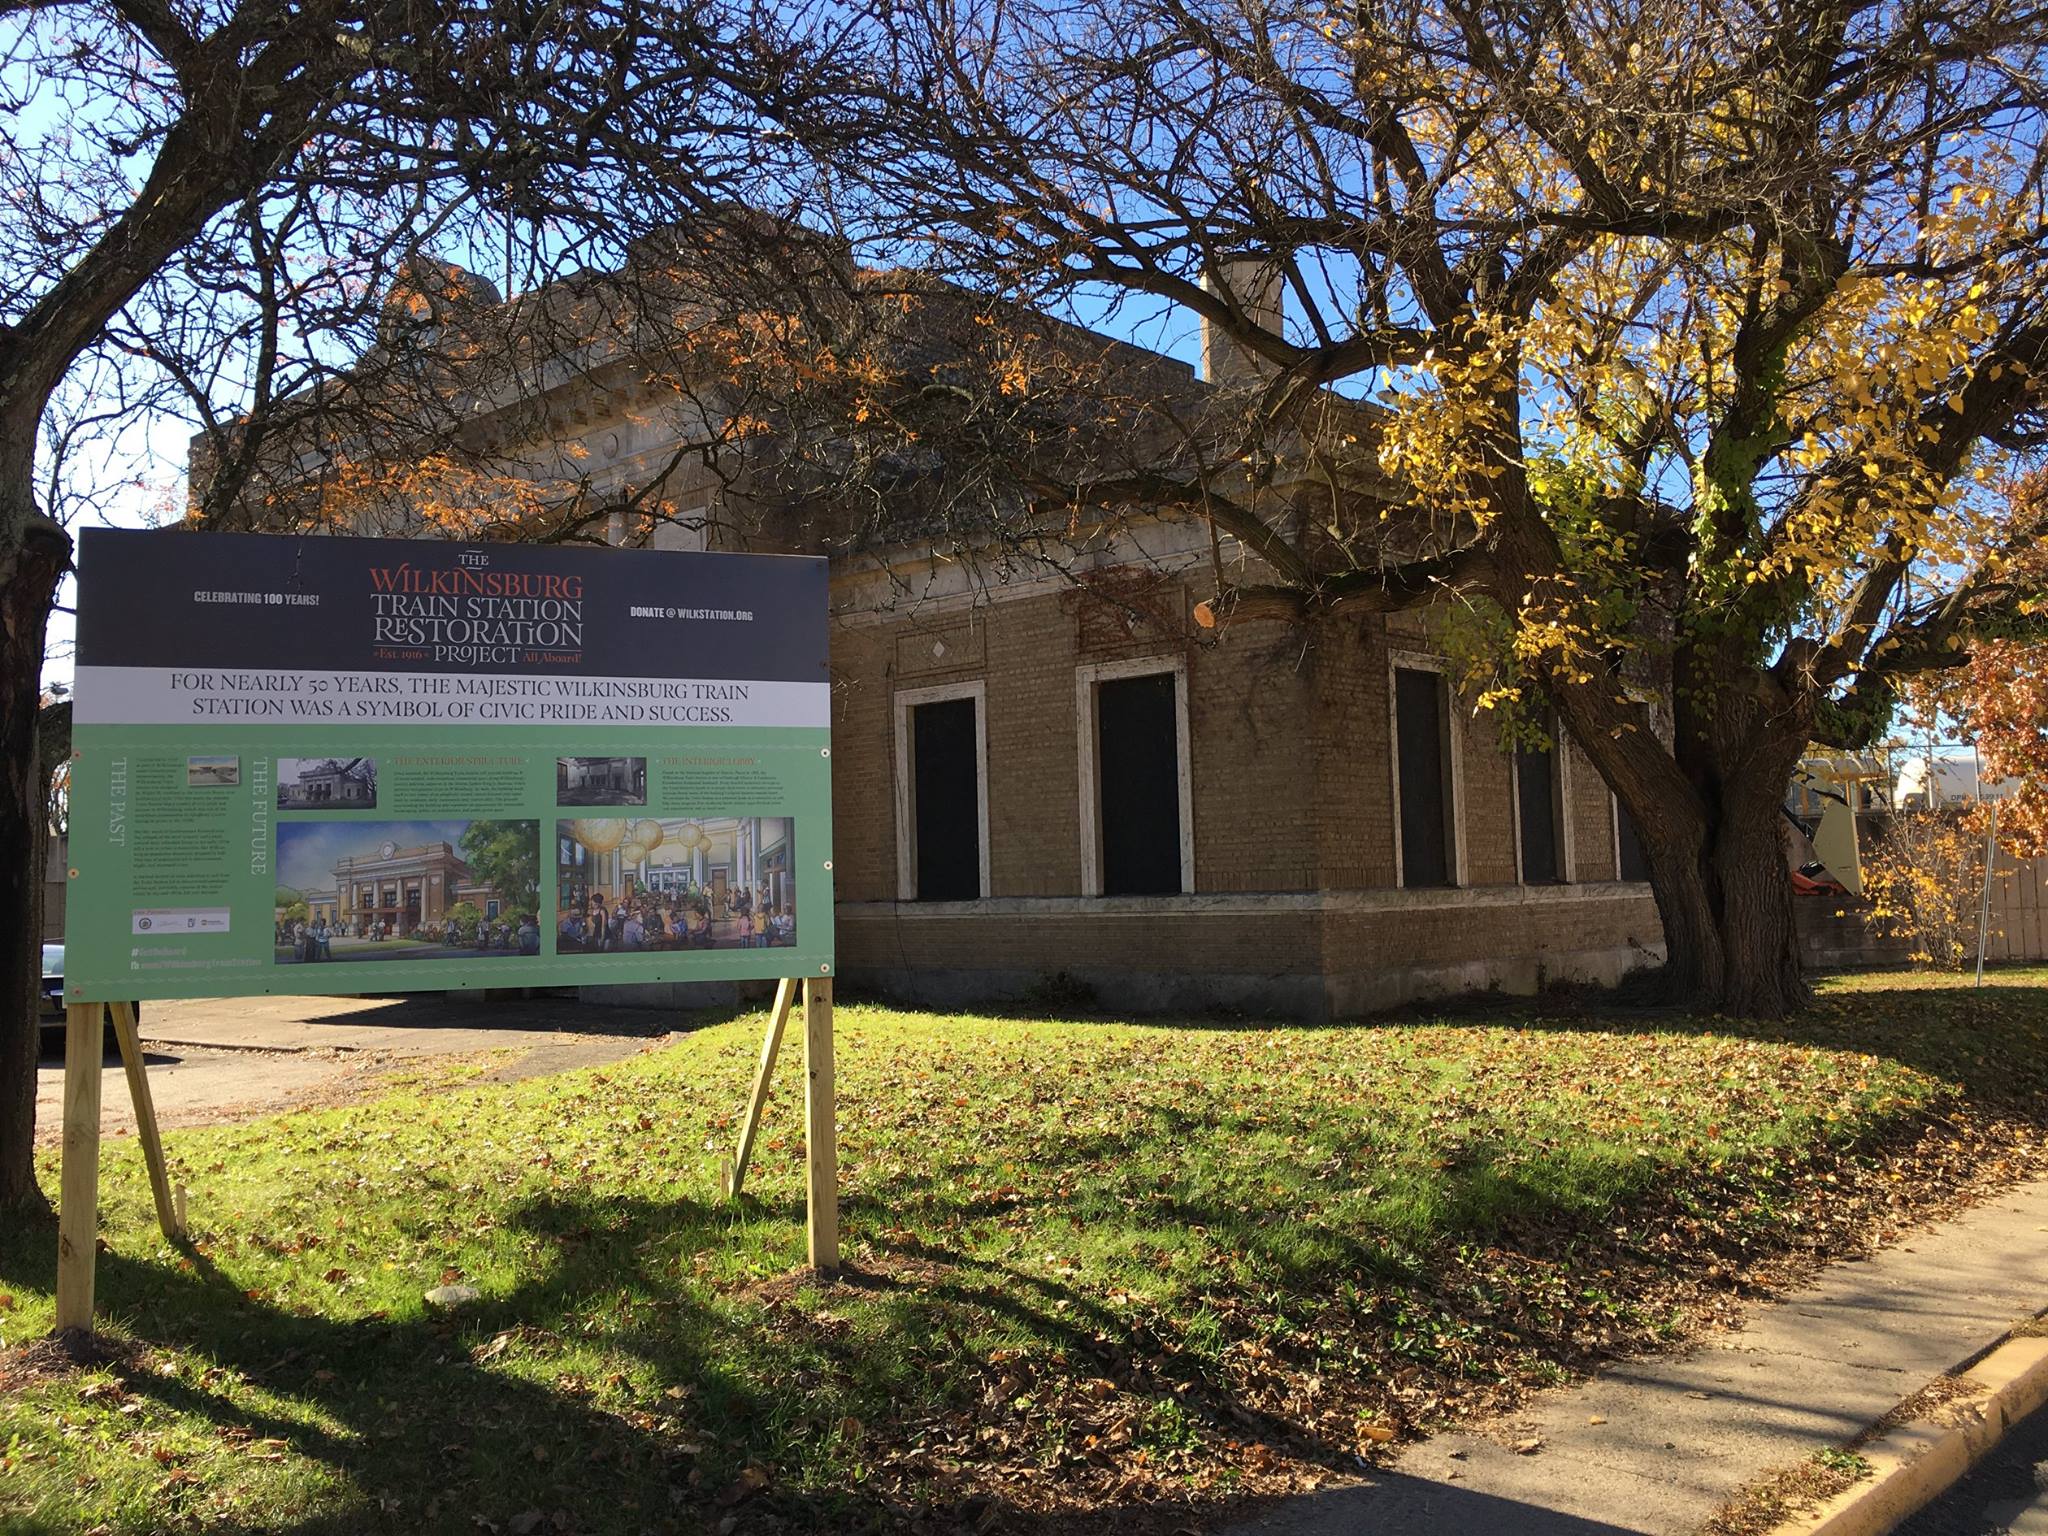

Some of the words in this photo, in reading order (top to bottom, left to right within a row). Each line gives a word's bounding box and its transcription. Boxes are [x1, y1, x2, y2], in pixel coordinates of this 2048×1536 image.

[458, 554, 489, 565] THE
[369, 563, 584, 599] WILKINSBURG
[194, 591, 262, 605] CELEBRATING
[263, 593, 283, 605] 100
[284, 594, 319, 606] YEARS!
[370, 594, 458, 617] TRAIN
[466, 596, 584, 621] STATION
[630, 606, 664, 618] DONATE
[666, 608, 676, 618] @
[677, 608, 753, 621] WILKSTATION.ORG
[400, 650, 423, 661] 1916
[433, 645, 521, 666] PROJECT
[522, 652, 538, 663] All
[537, 652, 582, 665] Aboard!
[170, 673, 214, 691] FOR
[220, 674, 303, 692] NEARLY
[308, 680, 328, 693] 50
[333, 676, 403, 695] YEARS,
[408, 678, 450, 694] THE
[456, 679, 550, 698] MAJESTIC
[555, 681, 688, 699] WILKINSBURG
[692, 683, 749, 700] TRAIN
[192, 698, 284, 716] STATION
[290, 699, 333, 716] WAS
[338, 701, 351, 716] A
[356, 701, 443, 718] SYMBOL
[447, 701, 475, 718] OF
[479, 703, 535, 719] CIVIC
[540, 704, 598, 720] PRIDE
[601, 705, 645, 721] AND
[649, 706, 733, 722] SUCCESS.
[111, 757, 127, 797] THE
[252, 756, 268, 795] THE
[109, 800, 126, 847] PAST
[250, 801, 267, 875] FUTURE
